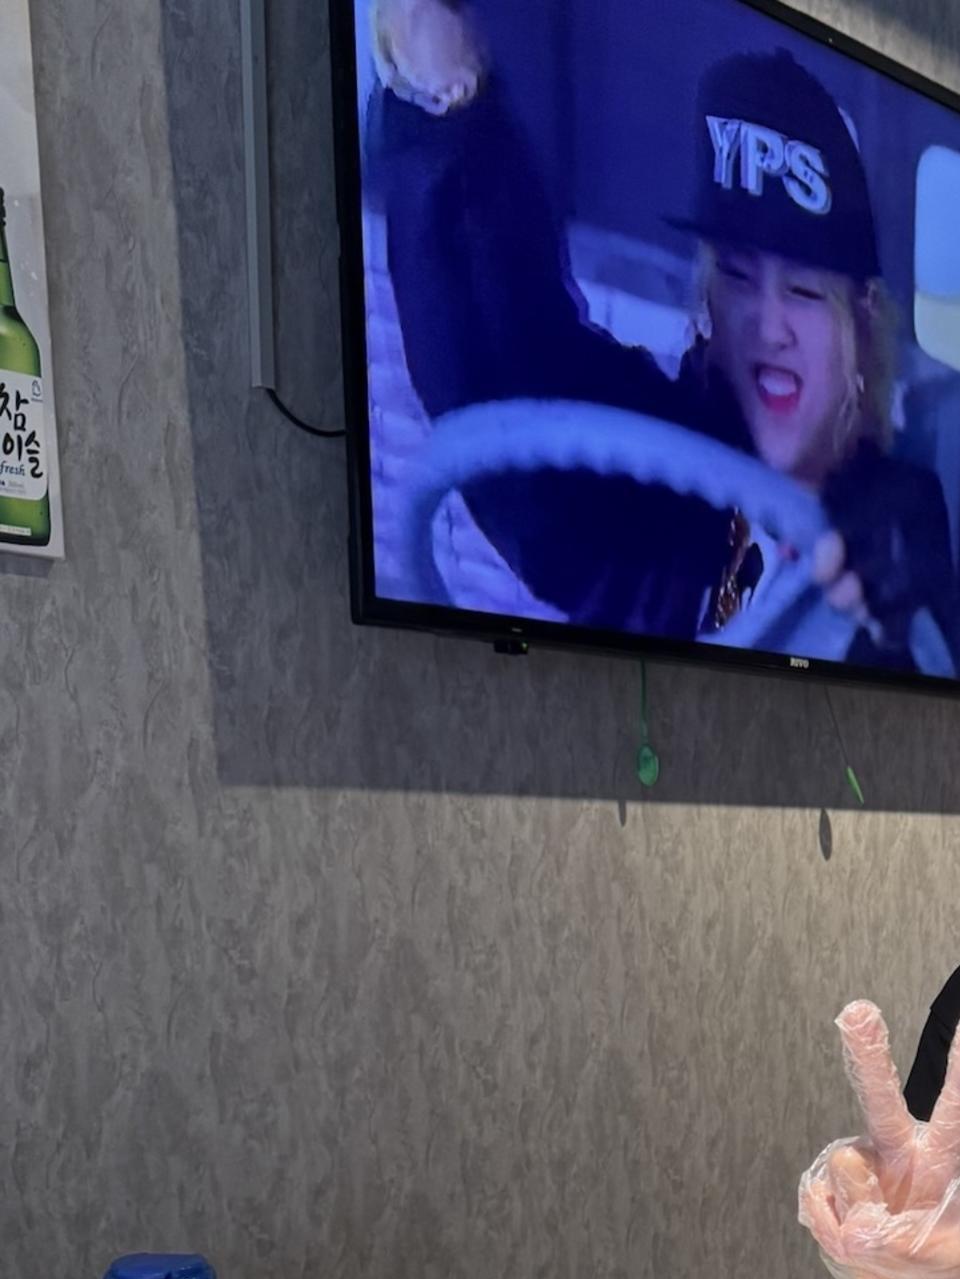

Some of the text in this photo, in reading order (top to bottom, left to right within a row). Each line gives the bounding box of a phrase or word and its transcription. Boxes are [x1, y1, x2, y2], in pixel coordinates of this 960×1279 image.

[706, 115, 832, 215] YPS
[0, 460, 25, 477] fresh
[2, 430, 44, 479] 이슬
